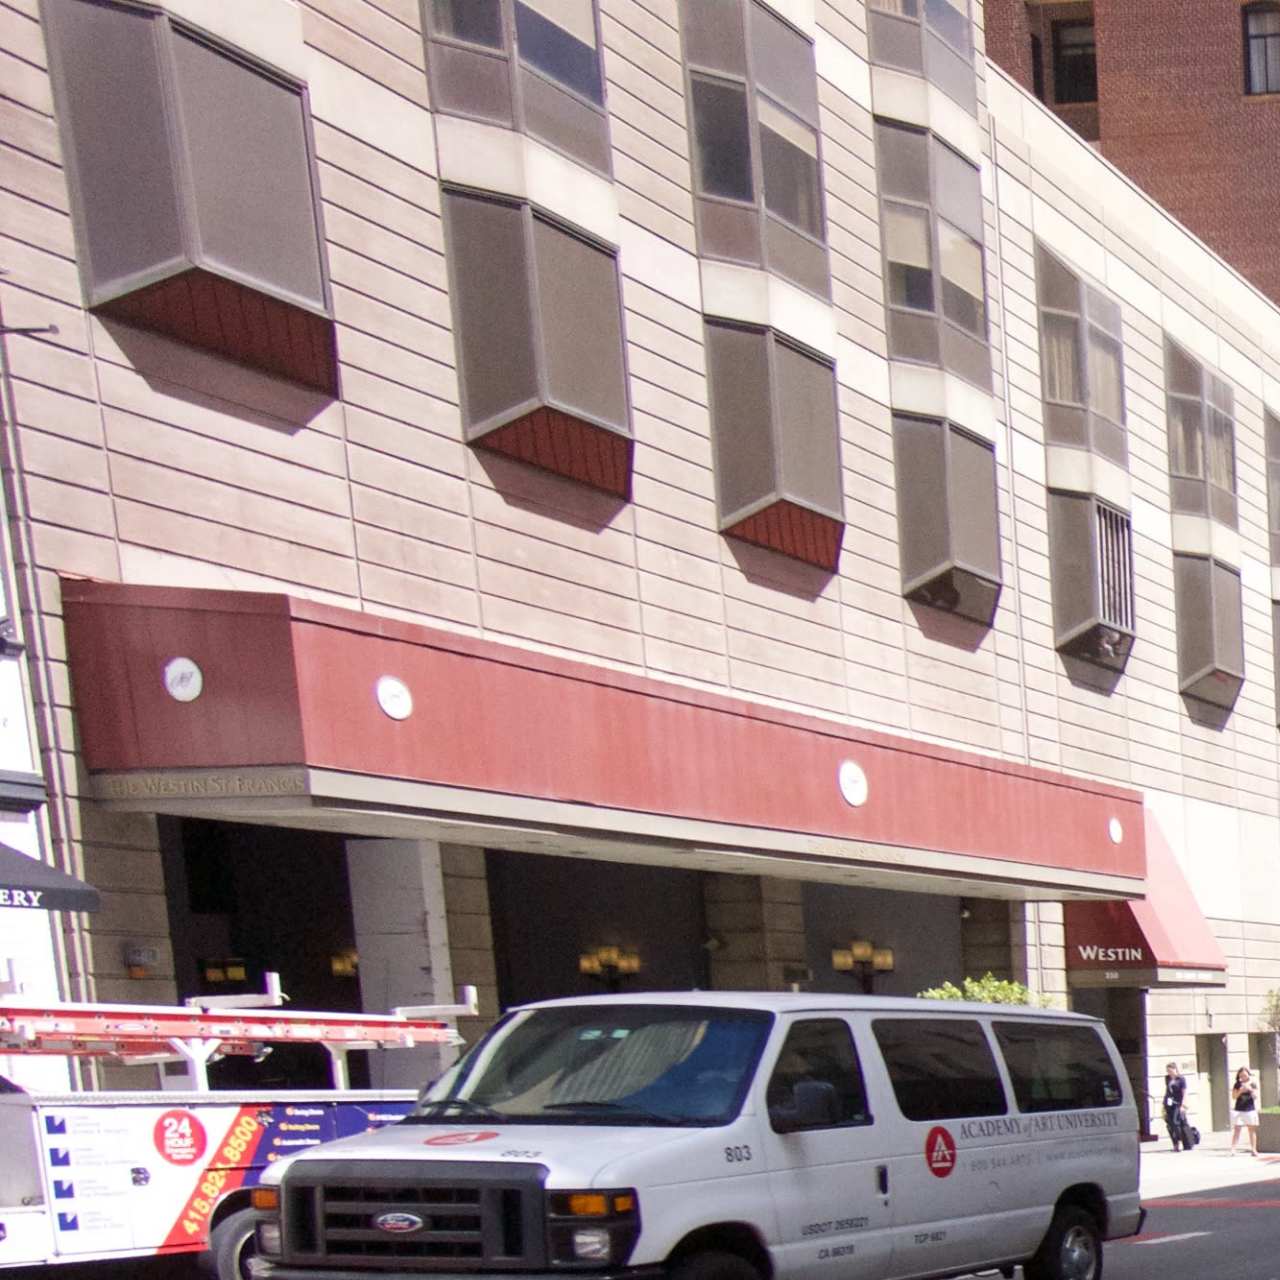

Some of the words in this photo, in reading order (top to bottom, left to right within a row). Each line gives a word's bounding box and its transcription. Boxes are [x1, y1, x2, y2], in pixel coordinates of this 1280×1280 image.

[143, 775, 207, 794] WESTIN
[237, 774, 305, 793] FRANCIS
[1078, 945, 1143, 961] WESTIN
[163, 1117, 193, 1137] 24
[959, 1117, 1022, 1140] ACADEMY
[1034, 1114, 1054, 1132] ART
[1056, 1111, 1119, 1130] UNIVERSITY
[725, 1145, 752, 1162] 803
